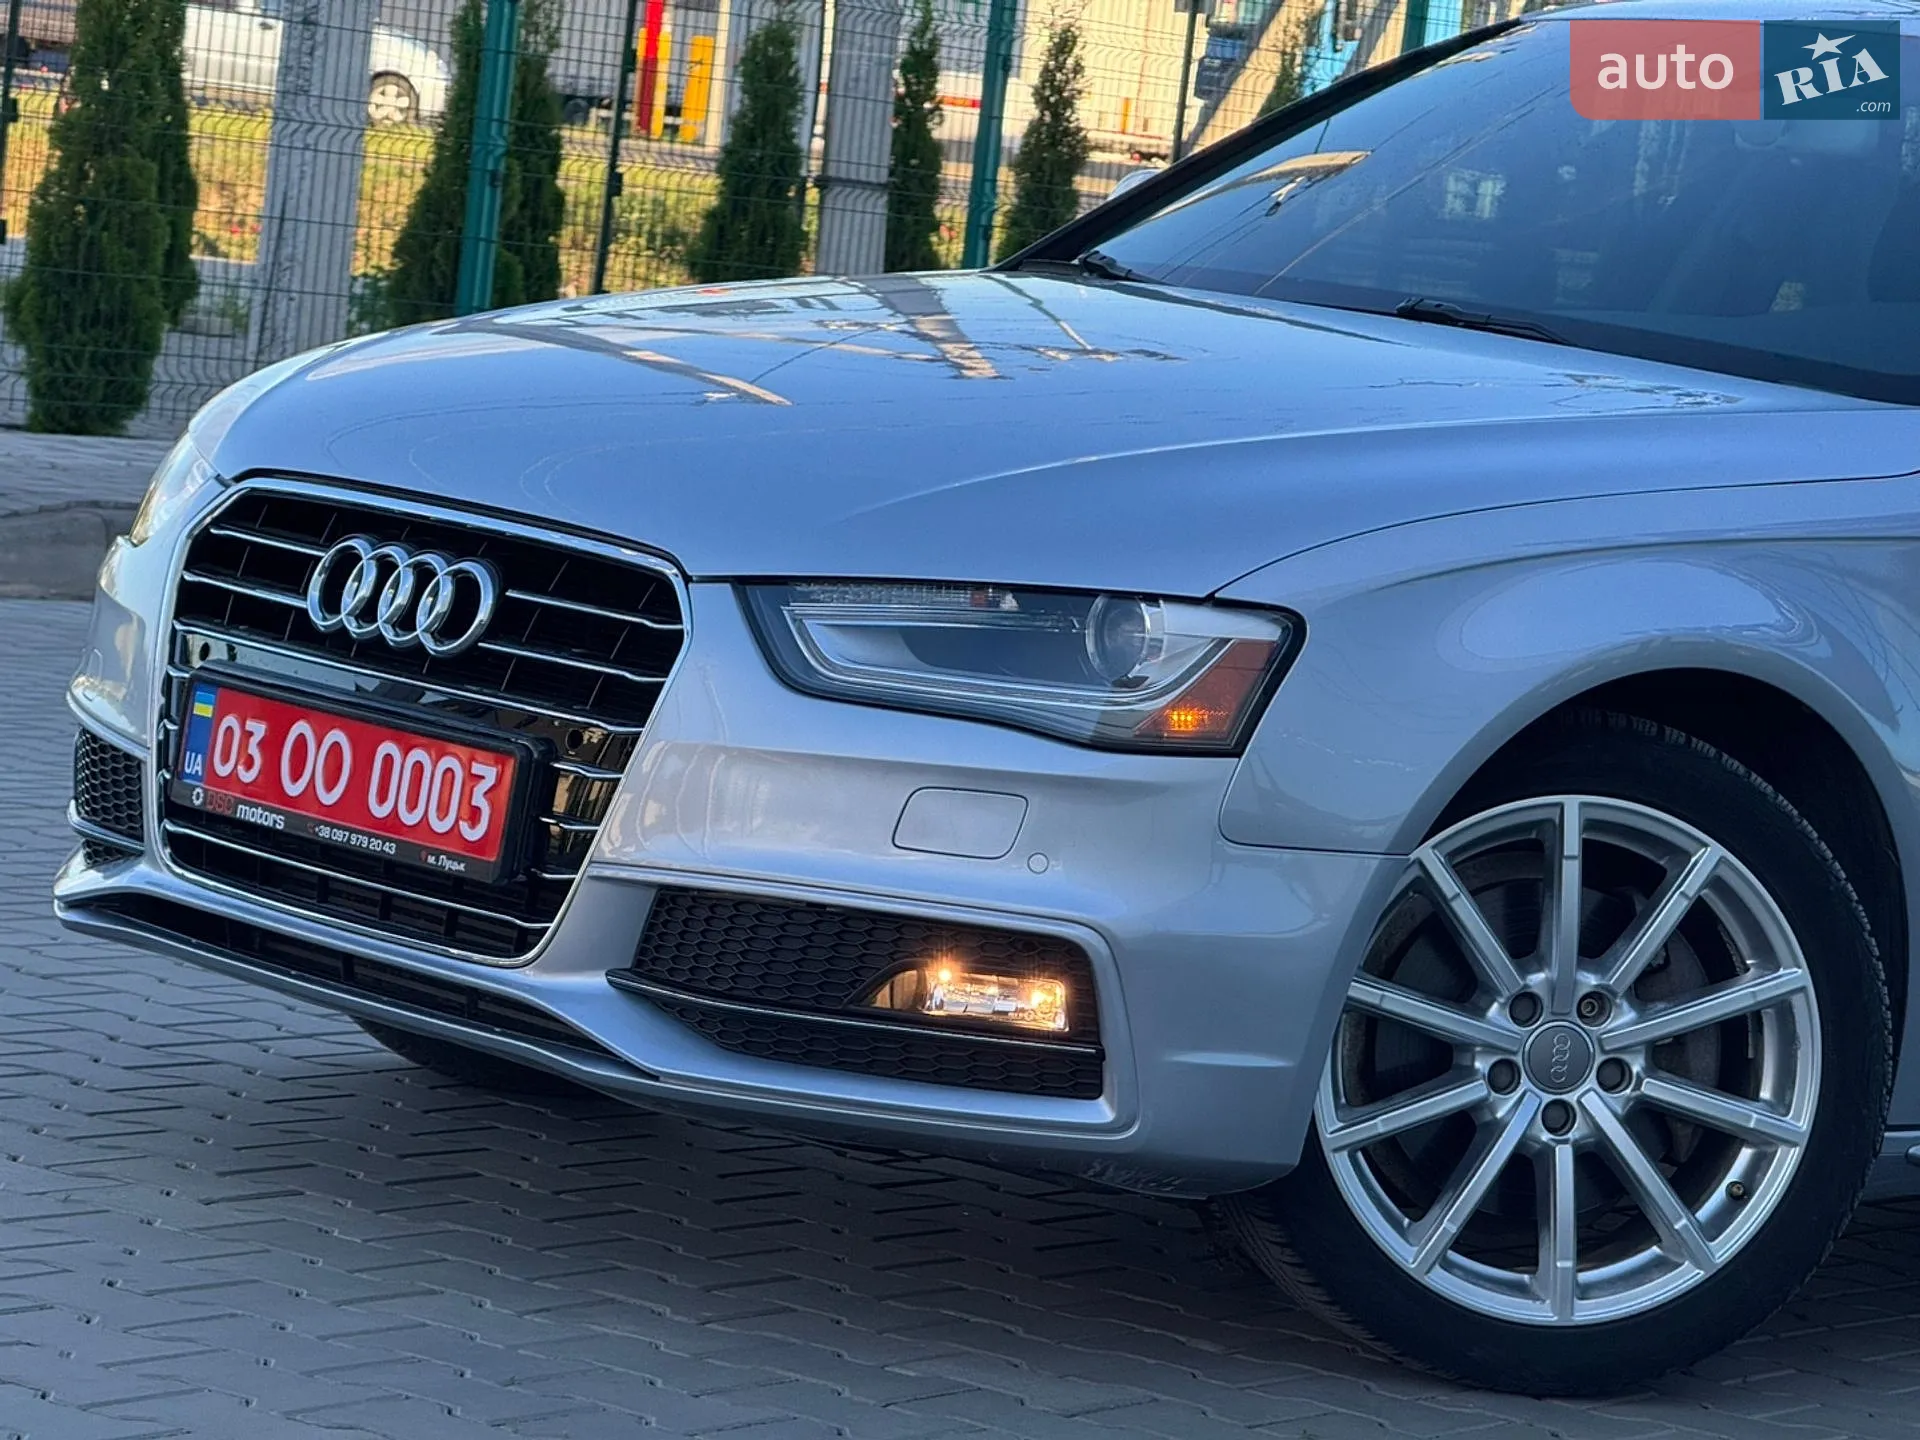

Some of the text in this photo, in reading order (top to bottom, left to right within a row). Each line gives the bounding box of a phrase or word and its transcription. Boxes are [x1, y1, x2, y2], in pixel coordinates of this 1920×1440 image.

[184, 751, 203, 776] UA
[213, 714, 266, 783] 03
[368, 740, 498, 842] 0003
[236, 804, 285, 829] motors
[331, 829, 349, 843] 097
[350, 833, 368, 848] 979
[369, 838, 382, 851] 20
[383, 841, 396, 854] 43
